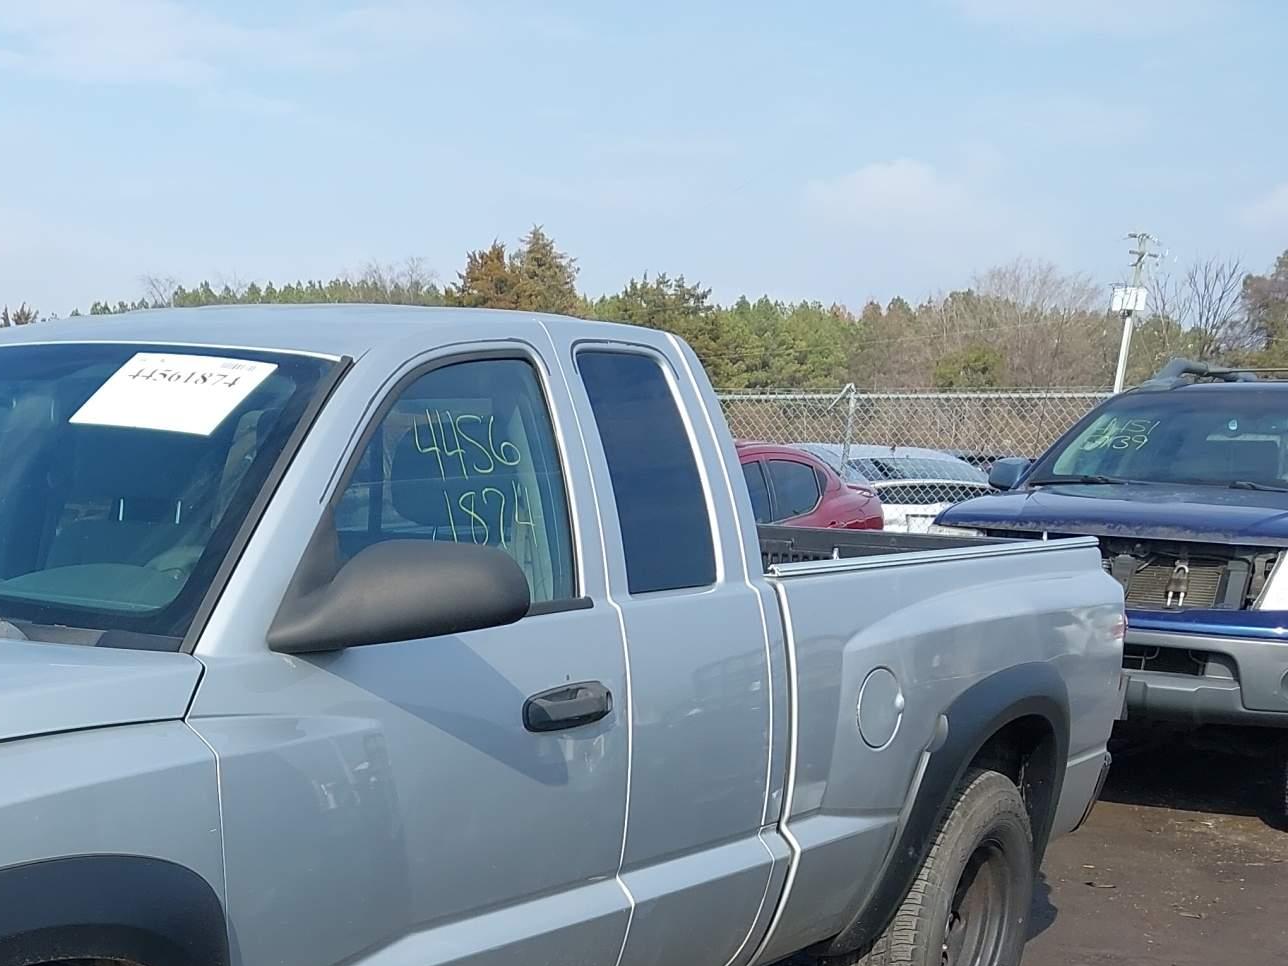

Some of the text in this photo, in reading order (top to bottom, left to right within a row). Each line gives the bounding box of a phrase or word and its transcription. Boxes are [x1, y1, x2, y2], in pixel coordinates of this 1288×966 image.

[127, 366, 241, 388] 44561874
[413, 409, 521, 481] 4456
[443, 479, 538, 549] 1874
